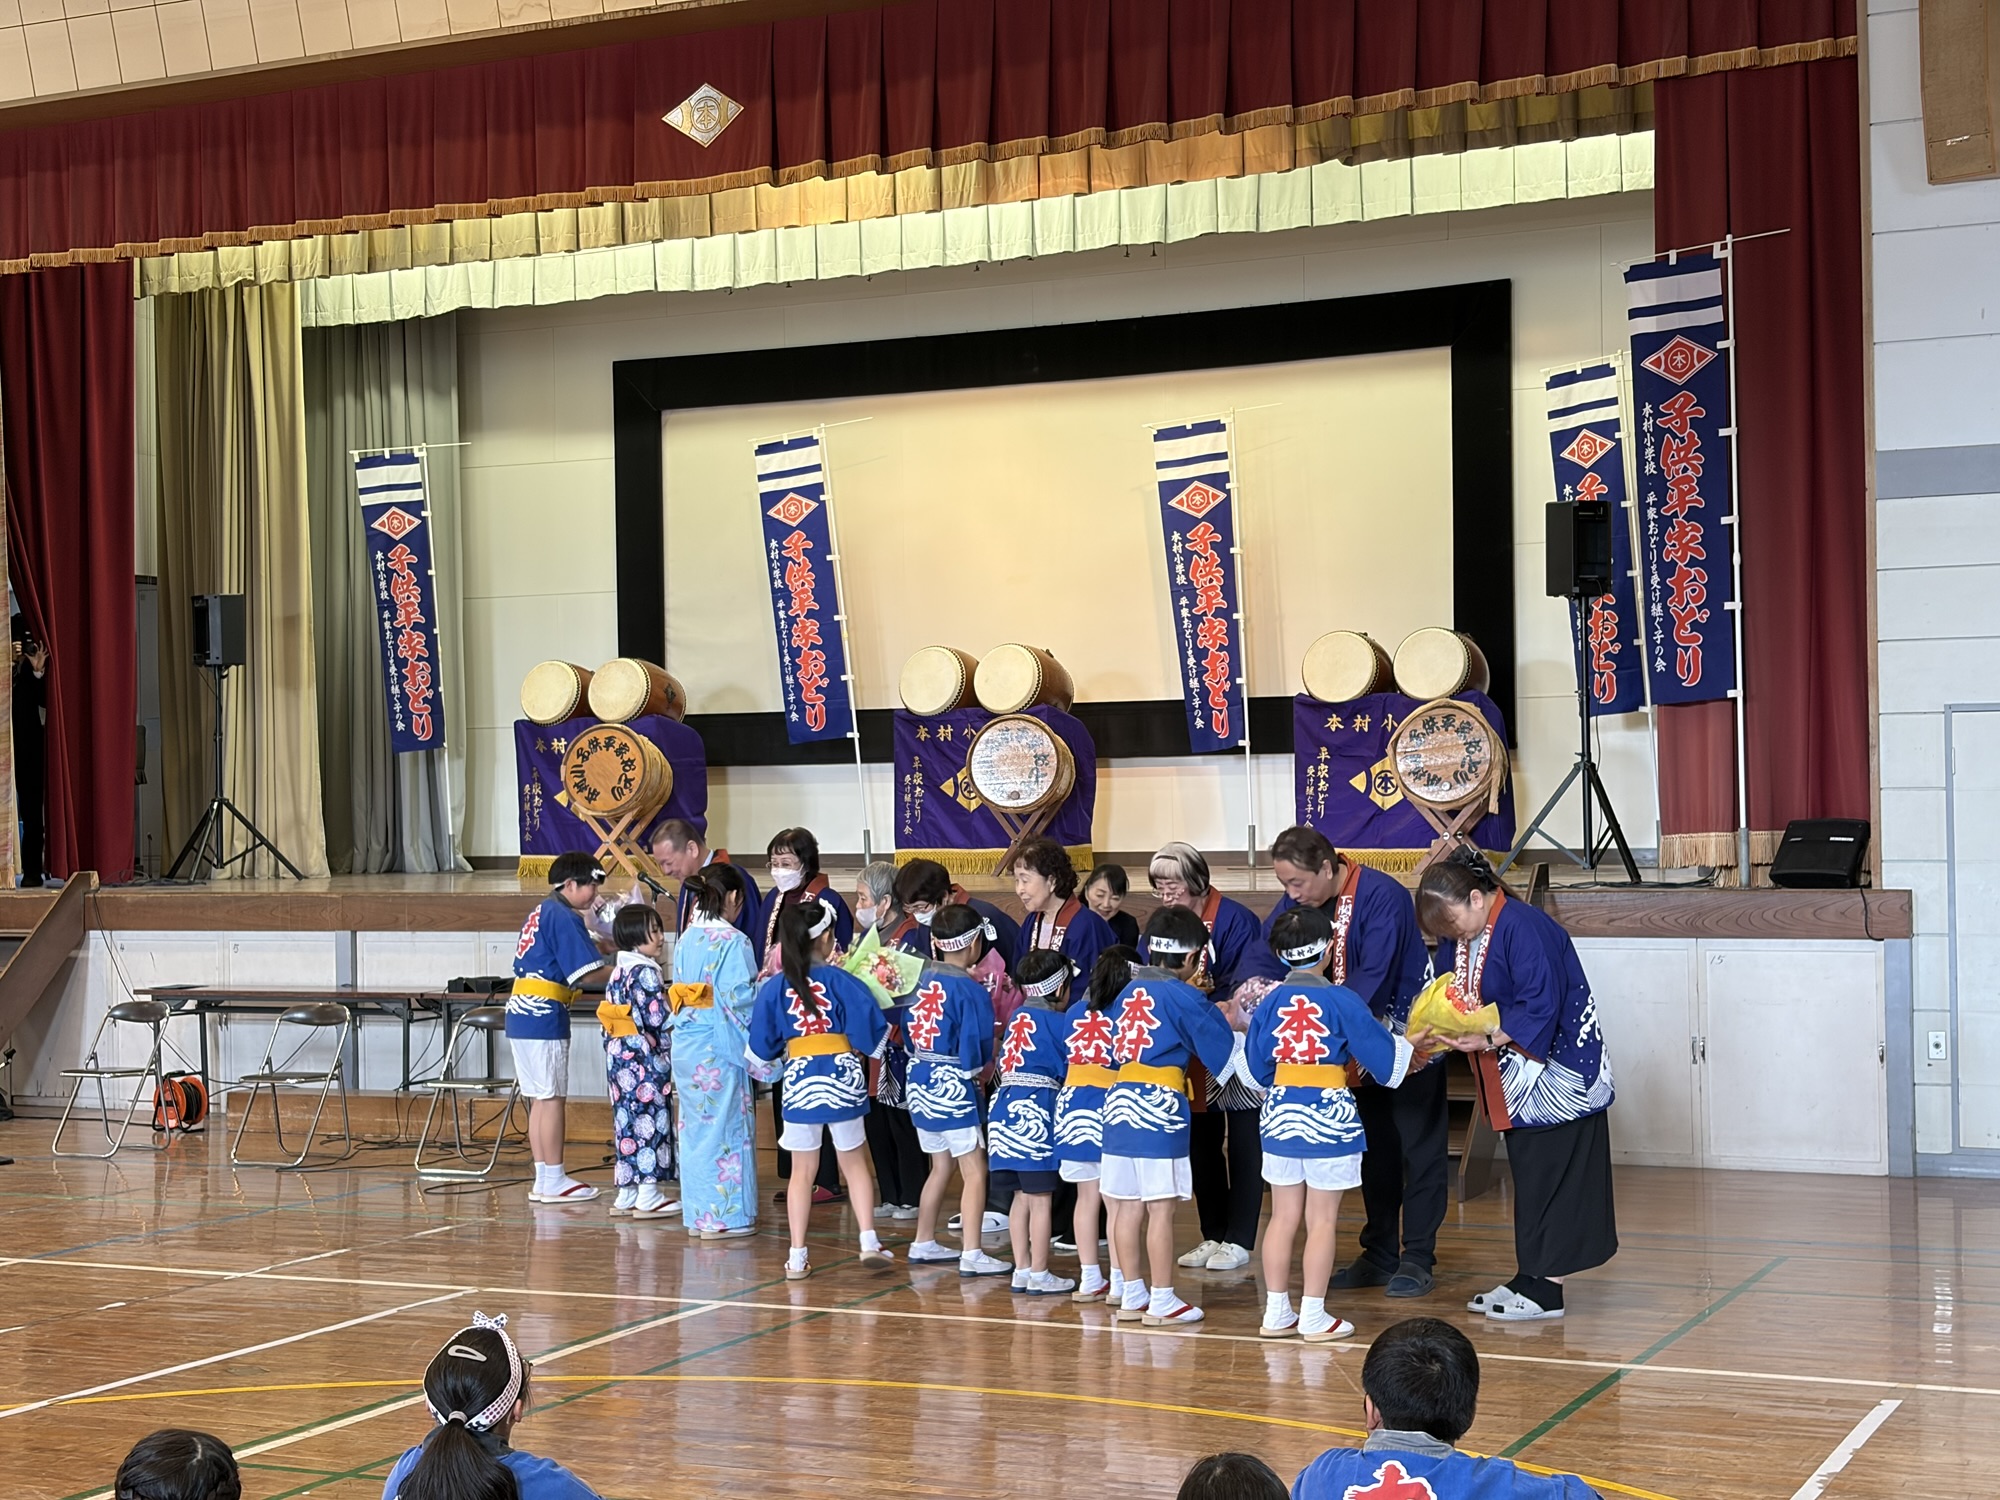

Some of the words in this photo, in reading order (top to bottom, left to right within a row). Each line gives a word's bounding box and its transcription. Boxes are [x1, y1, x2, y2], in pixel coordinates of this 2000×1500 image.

[696, 101, 717, 128] 本
[1656, 390, 1710, 687] 子供平家おどり
[387, 544, 433, 741] 子供平家おどり
[782, 530, 829, 732] 子供平家おどり
[1185, 521, 1230, 739] 子供平家おどり
[912, 755, 924, 823] 平家おどり
[1317, 746, 1331, 819] 平家おどり
[1710, 954, 1725, 965] 15
[908, 981, 946, 1051] 本村
[1113, 987, 1161, 1063] 本村
